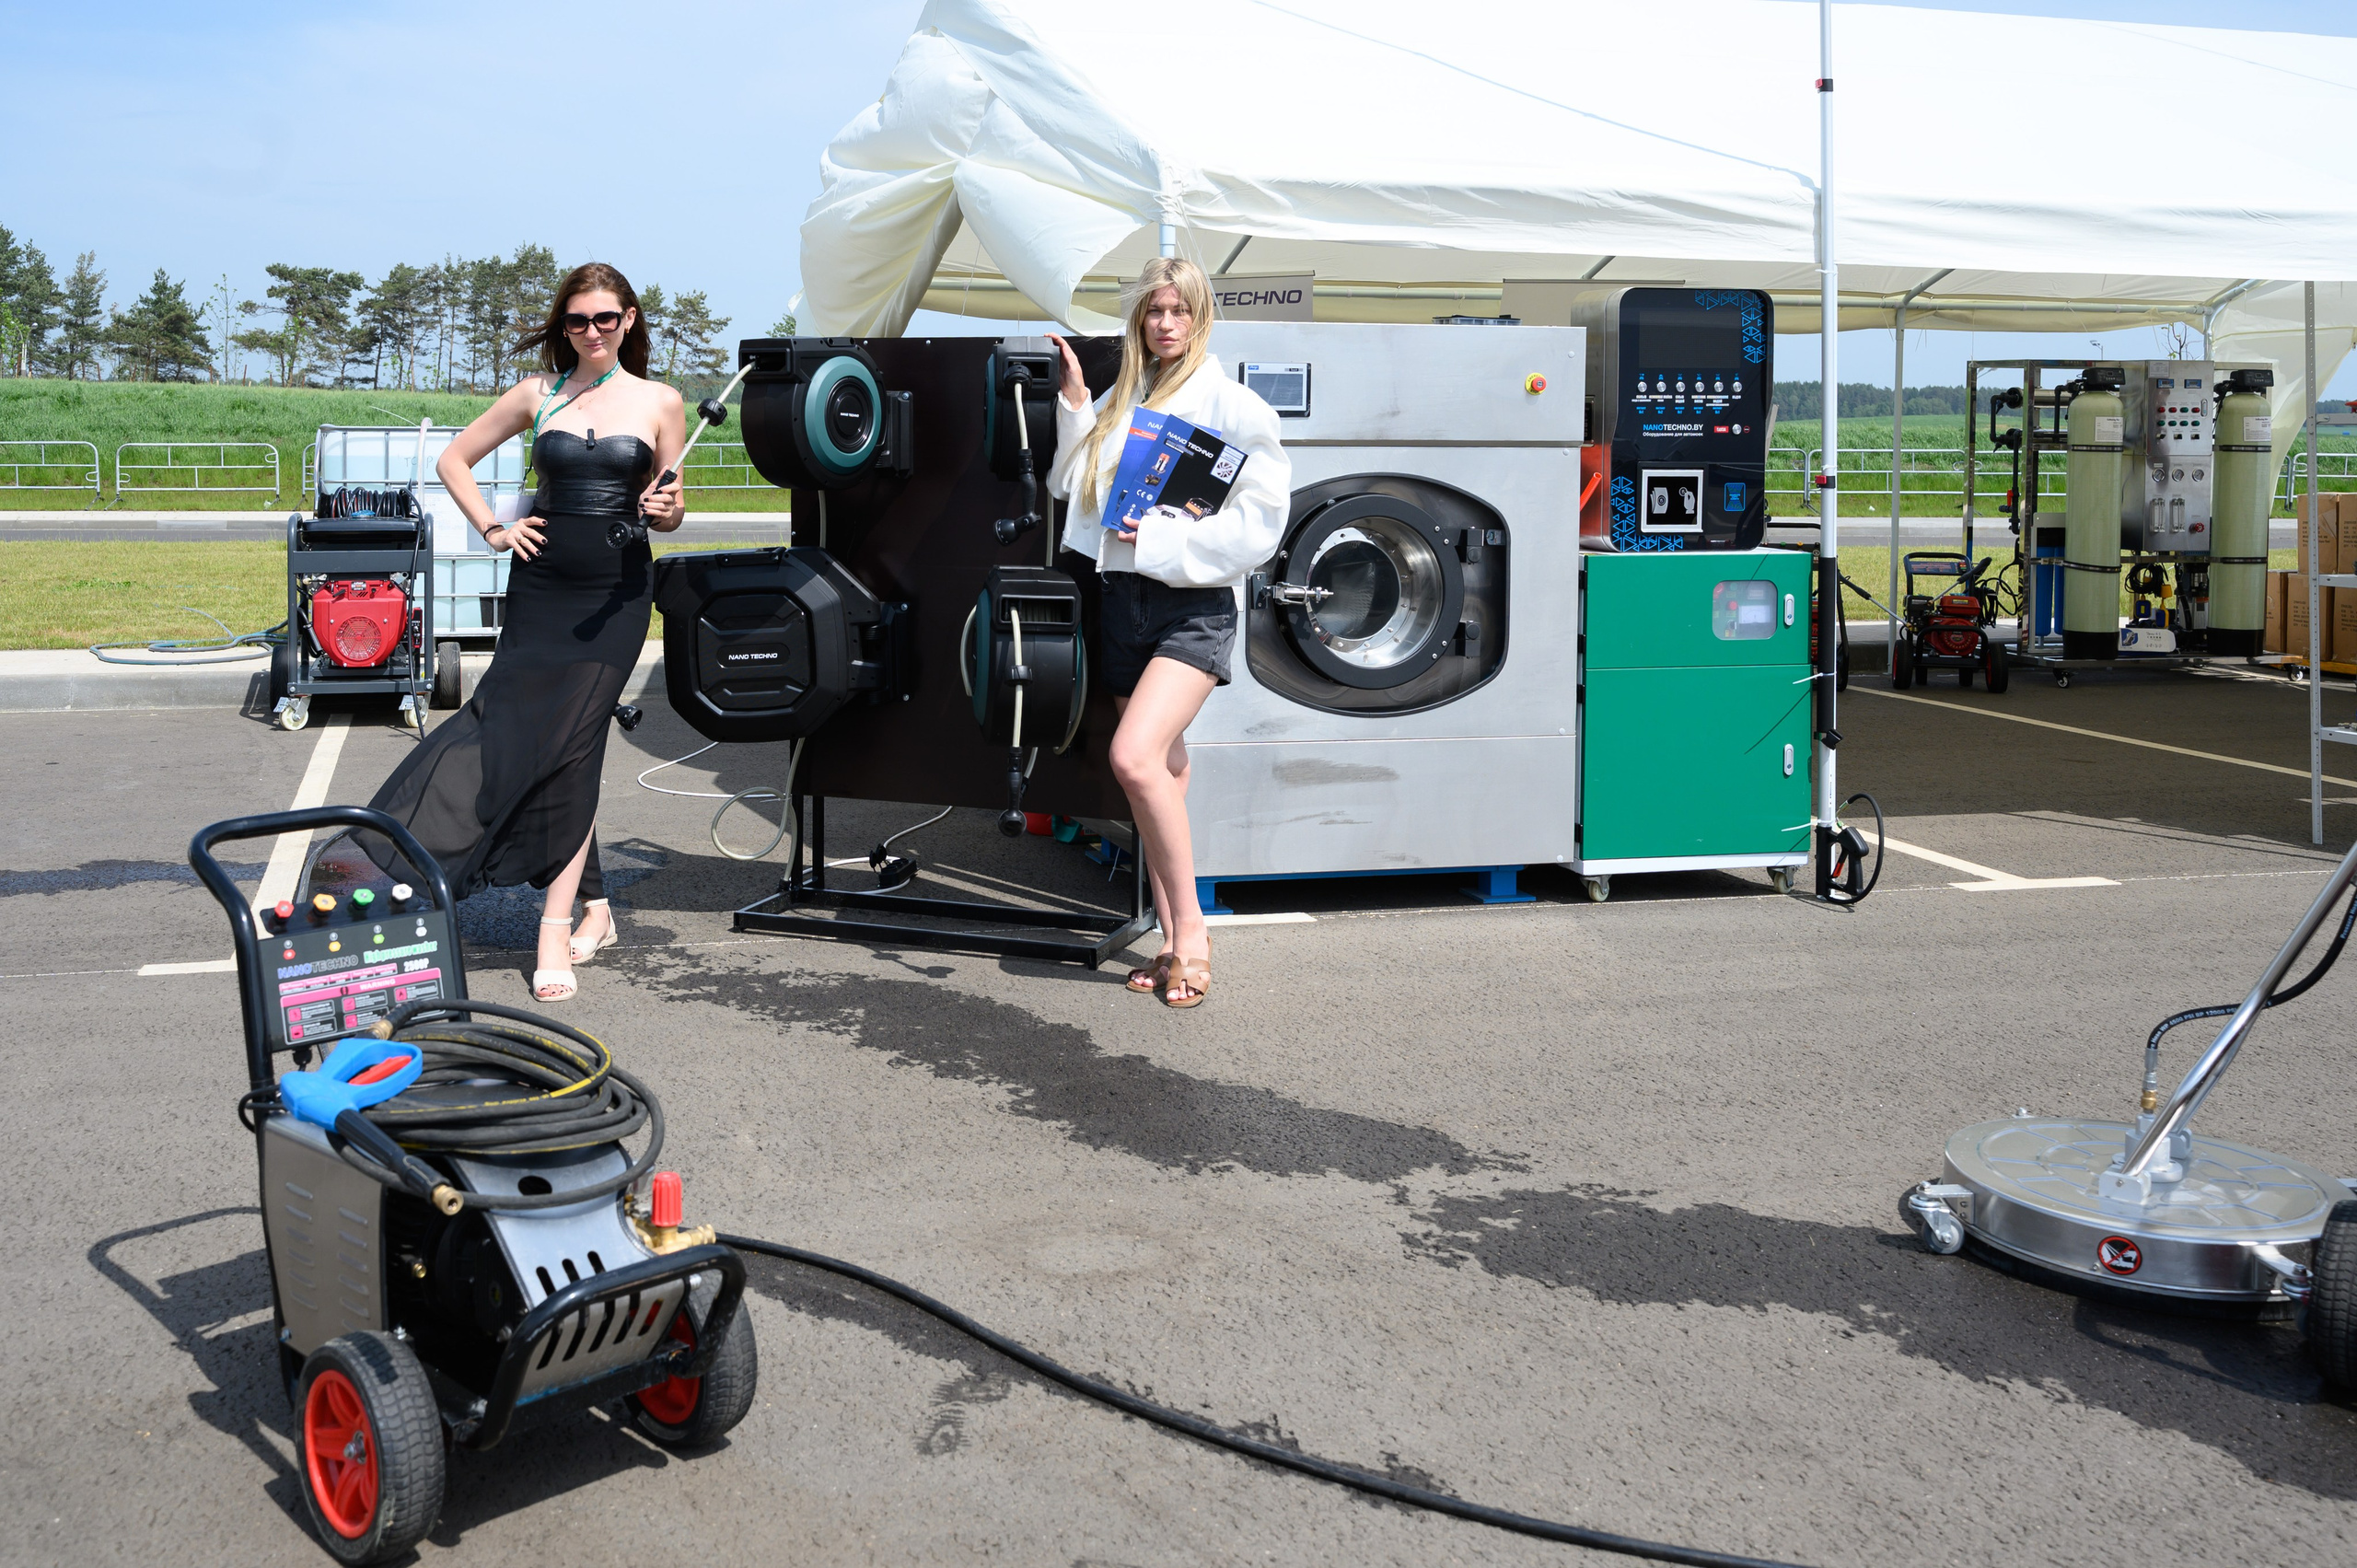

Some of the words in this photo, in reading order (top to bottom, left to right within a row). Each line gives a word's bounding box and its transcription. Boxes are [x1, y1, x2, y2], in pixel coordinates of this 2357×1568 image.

[1213, 289, 1303, 307] TECHNO
[1167, 431, 1188, 445] NANO
[1188, 441, 1213, 459] TECHNO
[277, 954, 359, 980] NANOTECHNO
[359, 978, 396, 991] WARNING
